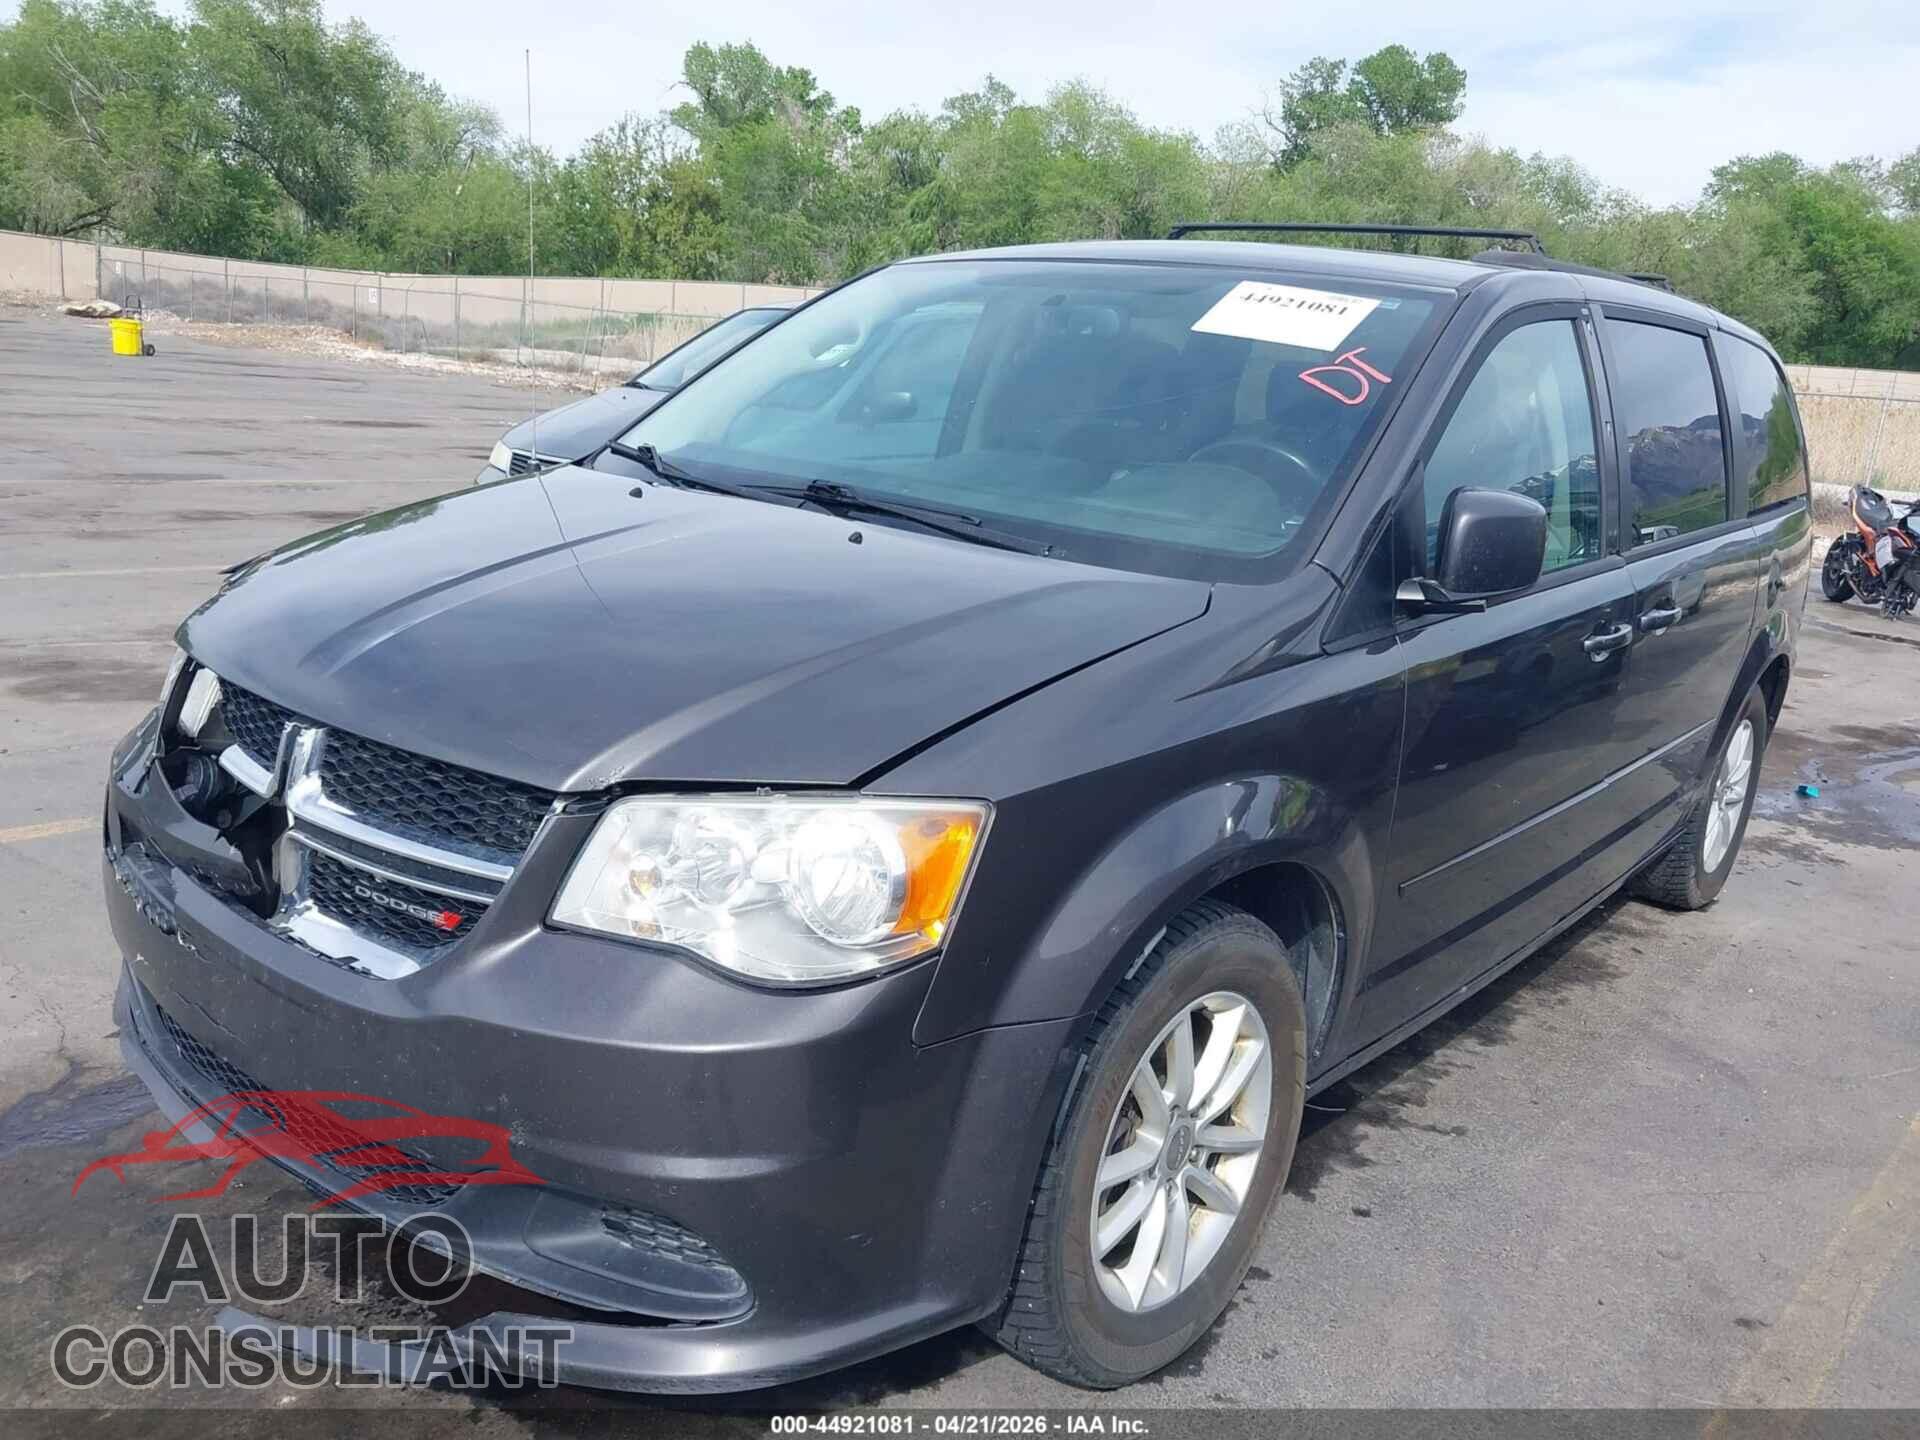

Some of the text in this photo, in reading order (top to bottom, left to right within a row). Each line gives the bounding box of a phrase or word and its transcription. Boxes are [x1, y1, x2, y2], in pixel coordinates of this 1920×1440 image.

[1240, 291, 1348, 315] 44921081
[1298, 347, 1392, 405] DT
[355, 885, 446, 926] DODGE
